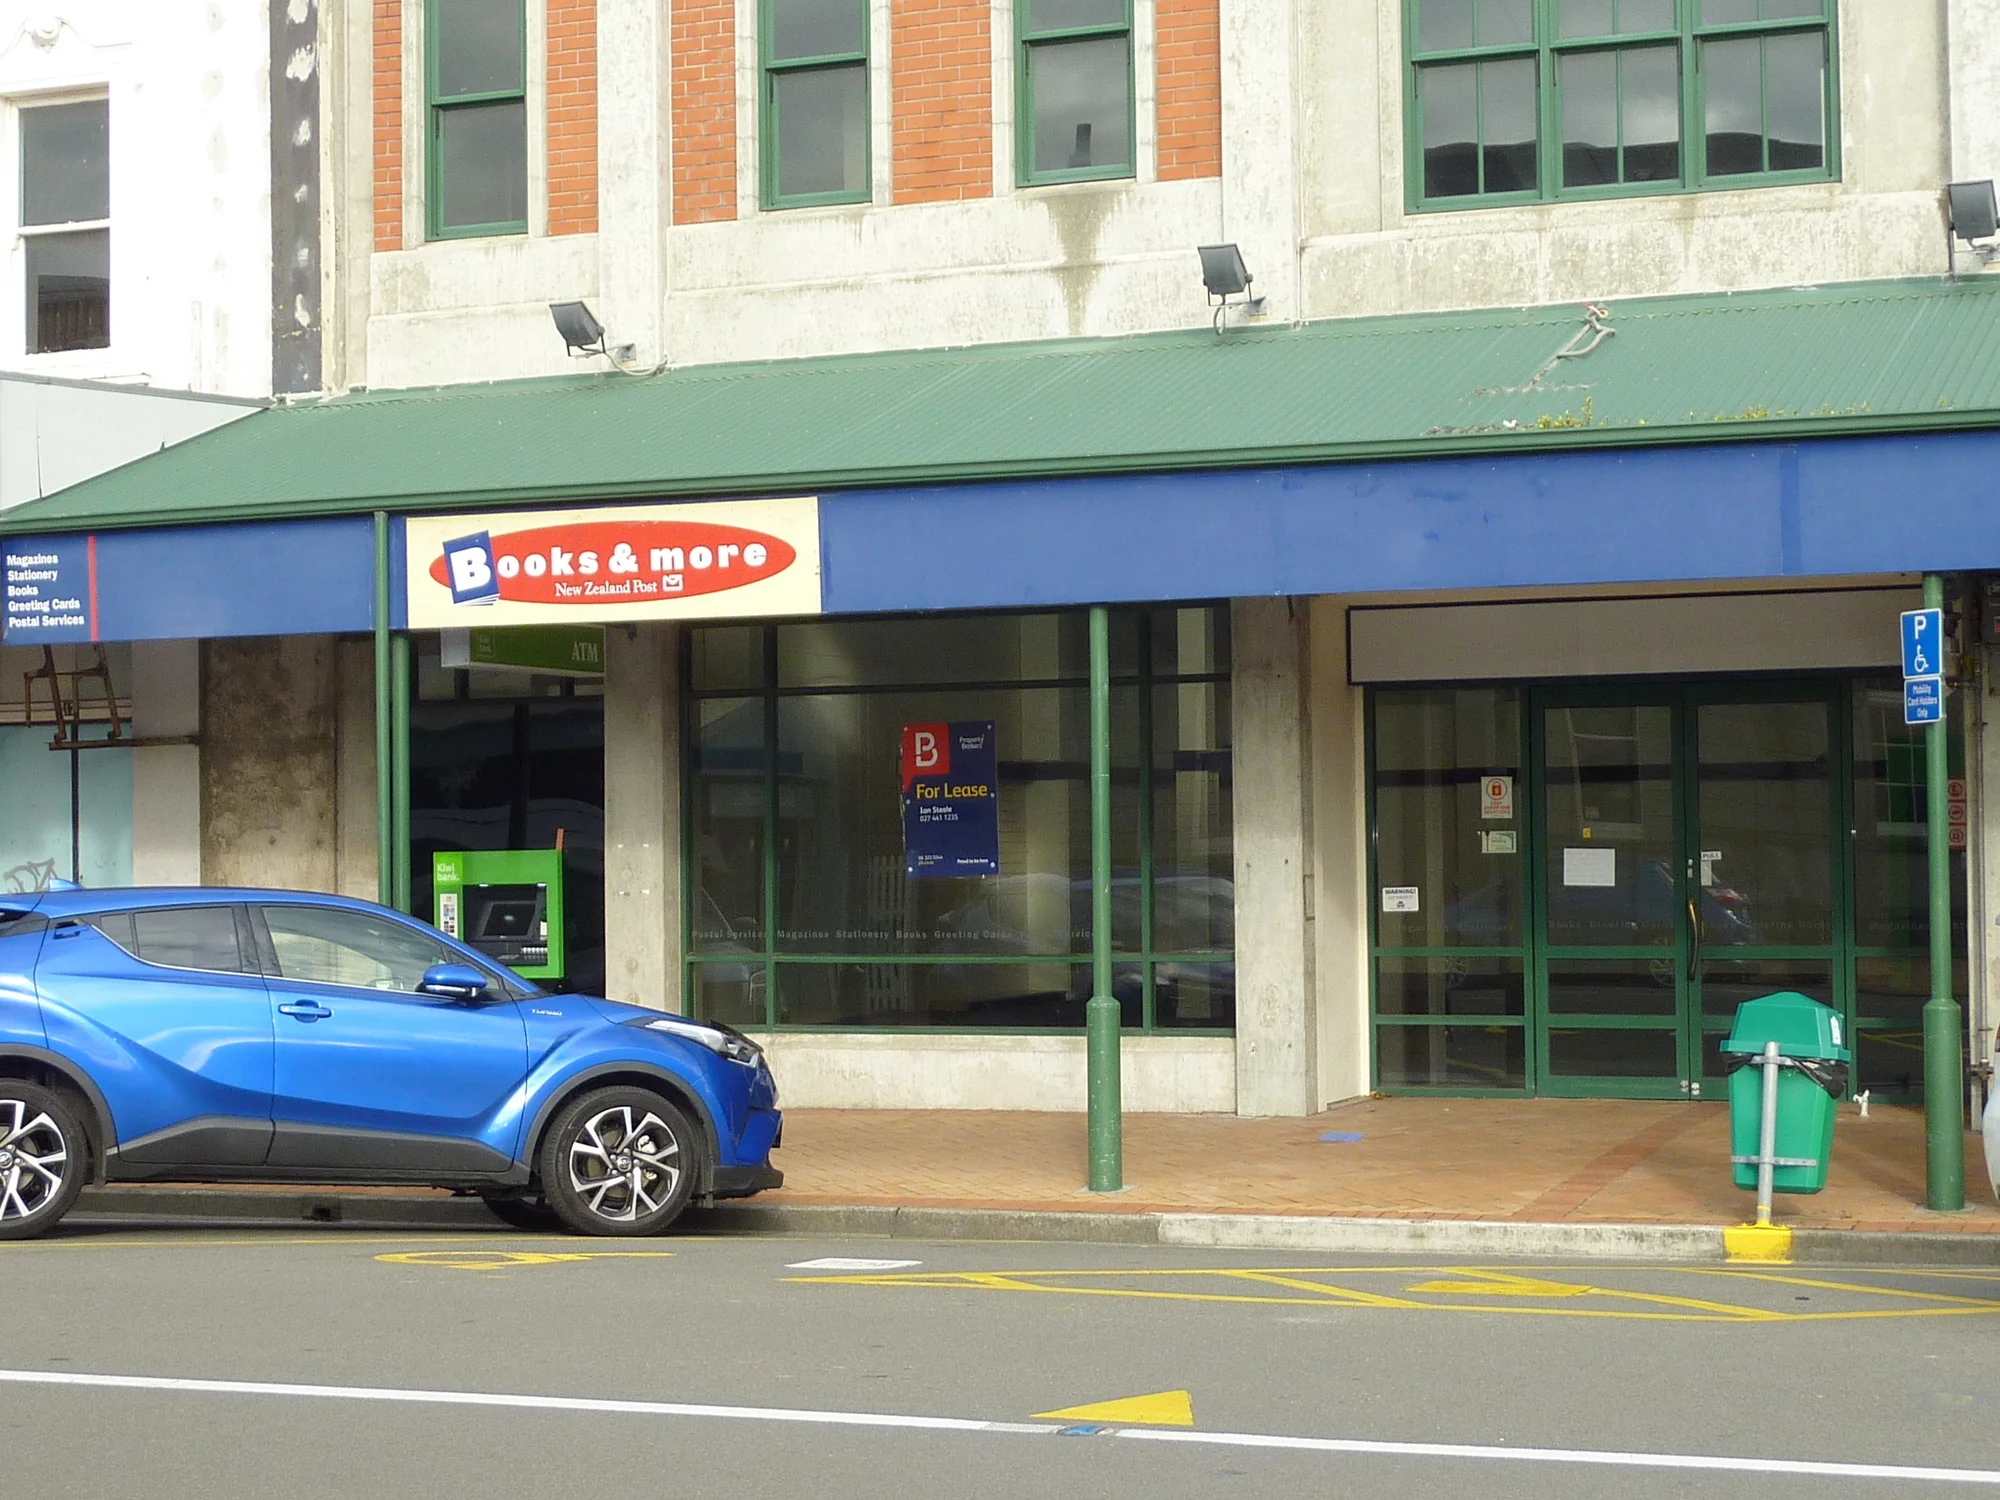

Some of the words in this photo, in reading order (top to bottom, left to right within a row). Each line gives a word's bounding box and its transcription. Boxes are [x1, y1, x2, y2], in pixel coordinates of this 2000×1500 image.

[7, 553, 59, 567] Magazines
[450, 546, 599, 591] Books
[608, 542, 638, 574] &
[650, 542, 767, 574] more
[7, 569, 58, 582] Stationery
[8, 584, 39, 596] Books
[555, 582, 582, 597] New
[584, 580, 630, 596] Zealand
[632, 580, 658, 594] Post
[8, 599, 50, 612] Greeting
[52, 597, 81, 609] Cards
[9, 615, 40, 628] Postal
[42, 614, 85, 626] Services
[1914, 615, 1927, 640] P
[571, 640, 599, 663] ATM
[1912, 684, 1932, 695] Mobility
[1907, 696, 1919, 706] Card
[1916, 708, 1928, 718] Only
[916, 783, 940, 799] For
[944, 782, 988, 798] Lease
[919, 806, 931, 814] Ian
[932, 805, 952, 814] Steele
[437, 863, 455, 872] Kiwi
[777, 929, 829, 939] Magazines
[835, 929, 889, 939] Stationery
